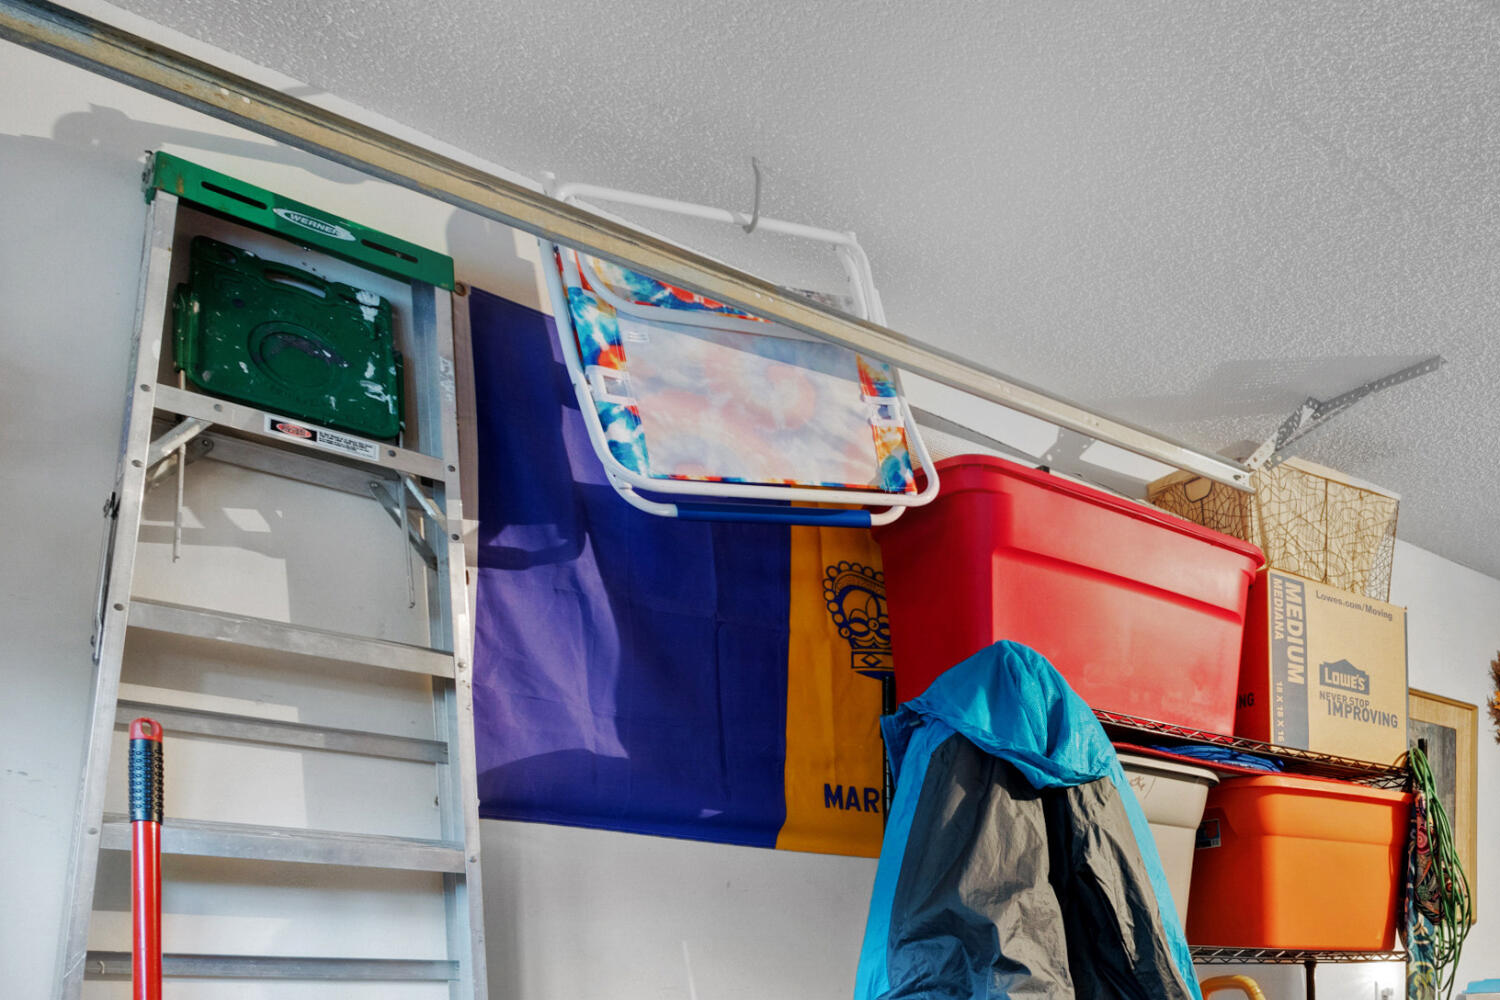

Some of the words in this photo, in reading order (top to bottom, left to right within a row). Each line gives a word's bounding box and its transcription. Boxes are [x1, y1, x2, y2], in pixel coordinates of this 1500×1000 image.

[1272, 577, 1285, 641] MEDIANA
[1315, 590, 1393, 622] Lowes.com/Moving
[1285, 580, 1305, 686] MEDIUM
[1319, 690, 1348, 703] NEVER
[1349, 696, 1370, 709] STOP
[1327, 700, 1398, 729] IMPROVING
[823, 783, 885, 814] MAR
